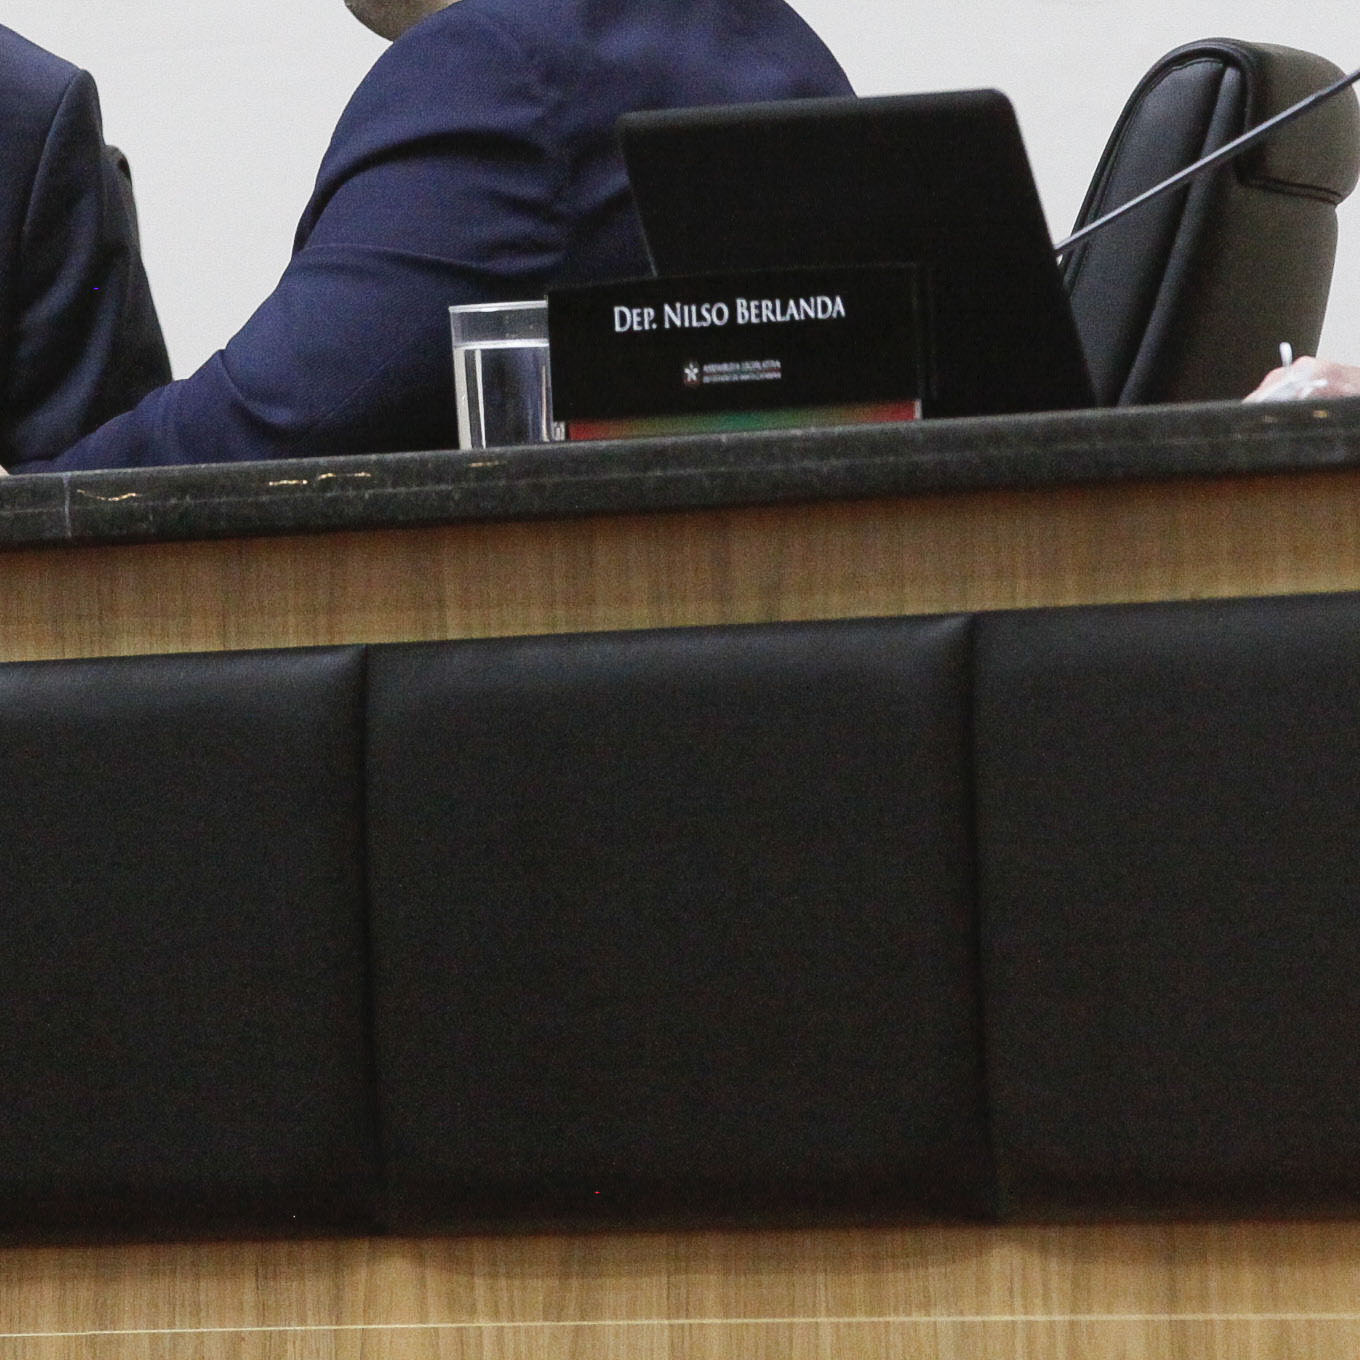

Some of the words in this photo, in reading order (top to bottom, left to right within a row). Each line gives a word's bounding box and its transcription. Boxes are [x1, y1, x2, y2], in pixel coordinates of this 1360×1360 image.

[613, 305, 658, 333] DEP.
[663, 301, 729, 329] NILSO
[736, 295, 846, 325] BERLANDA
